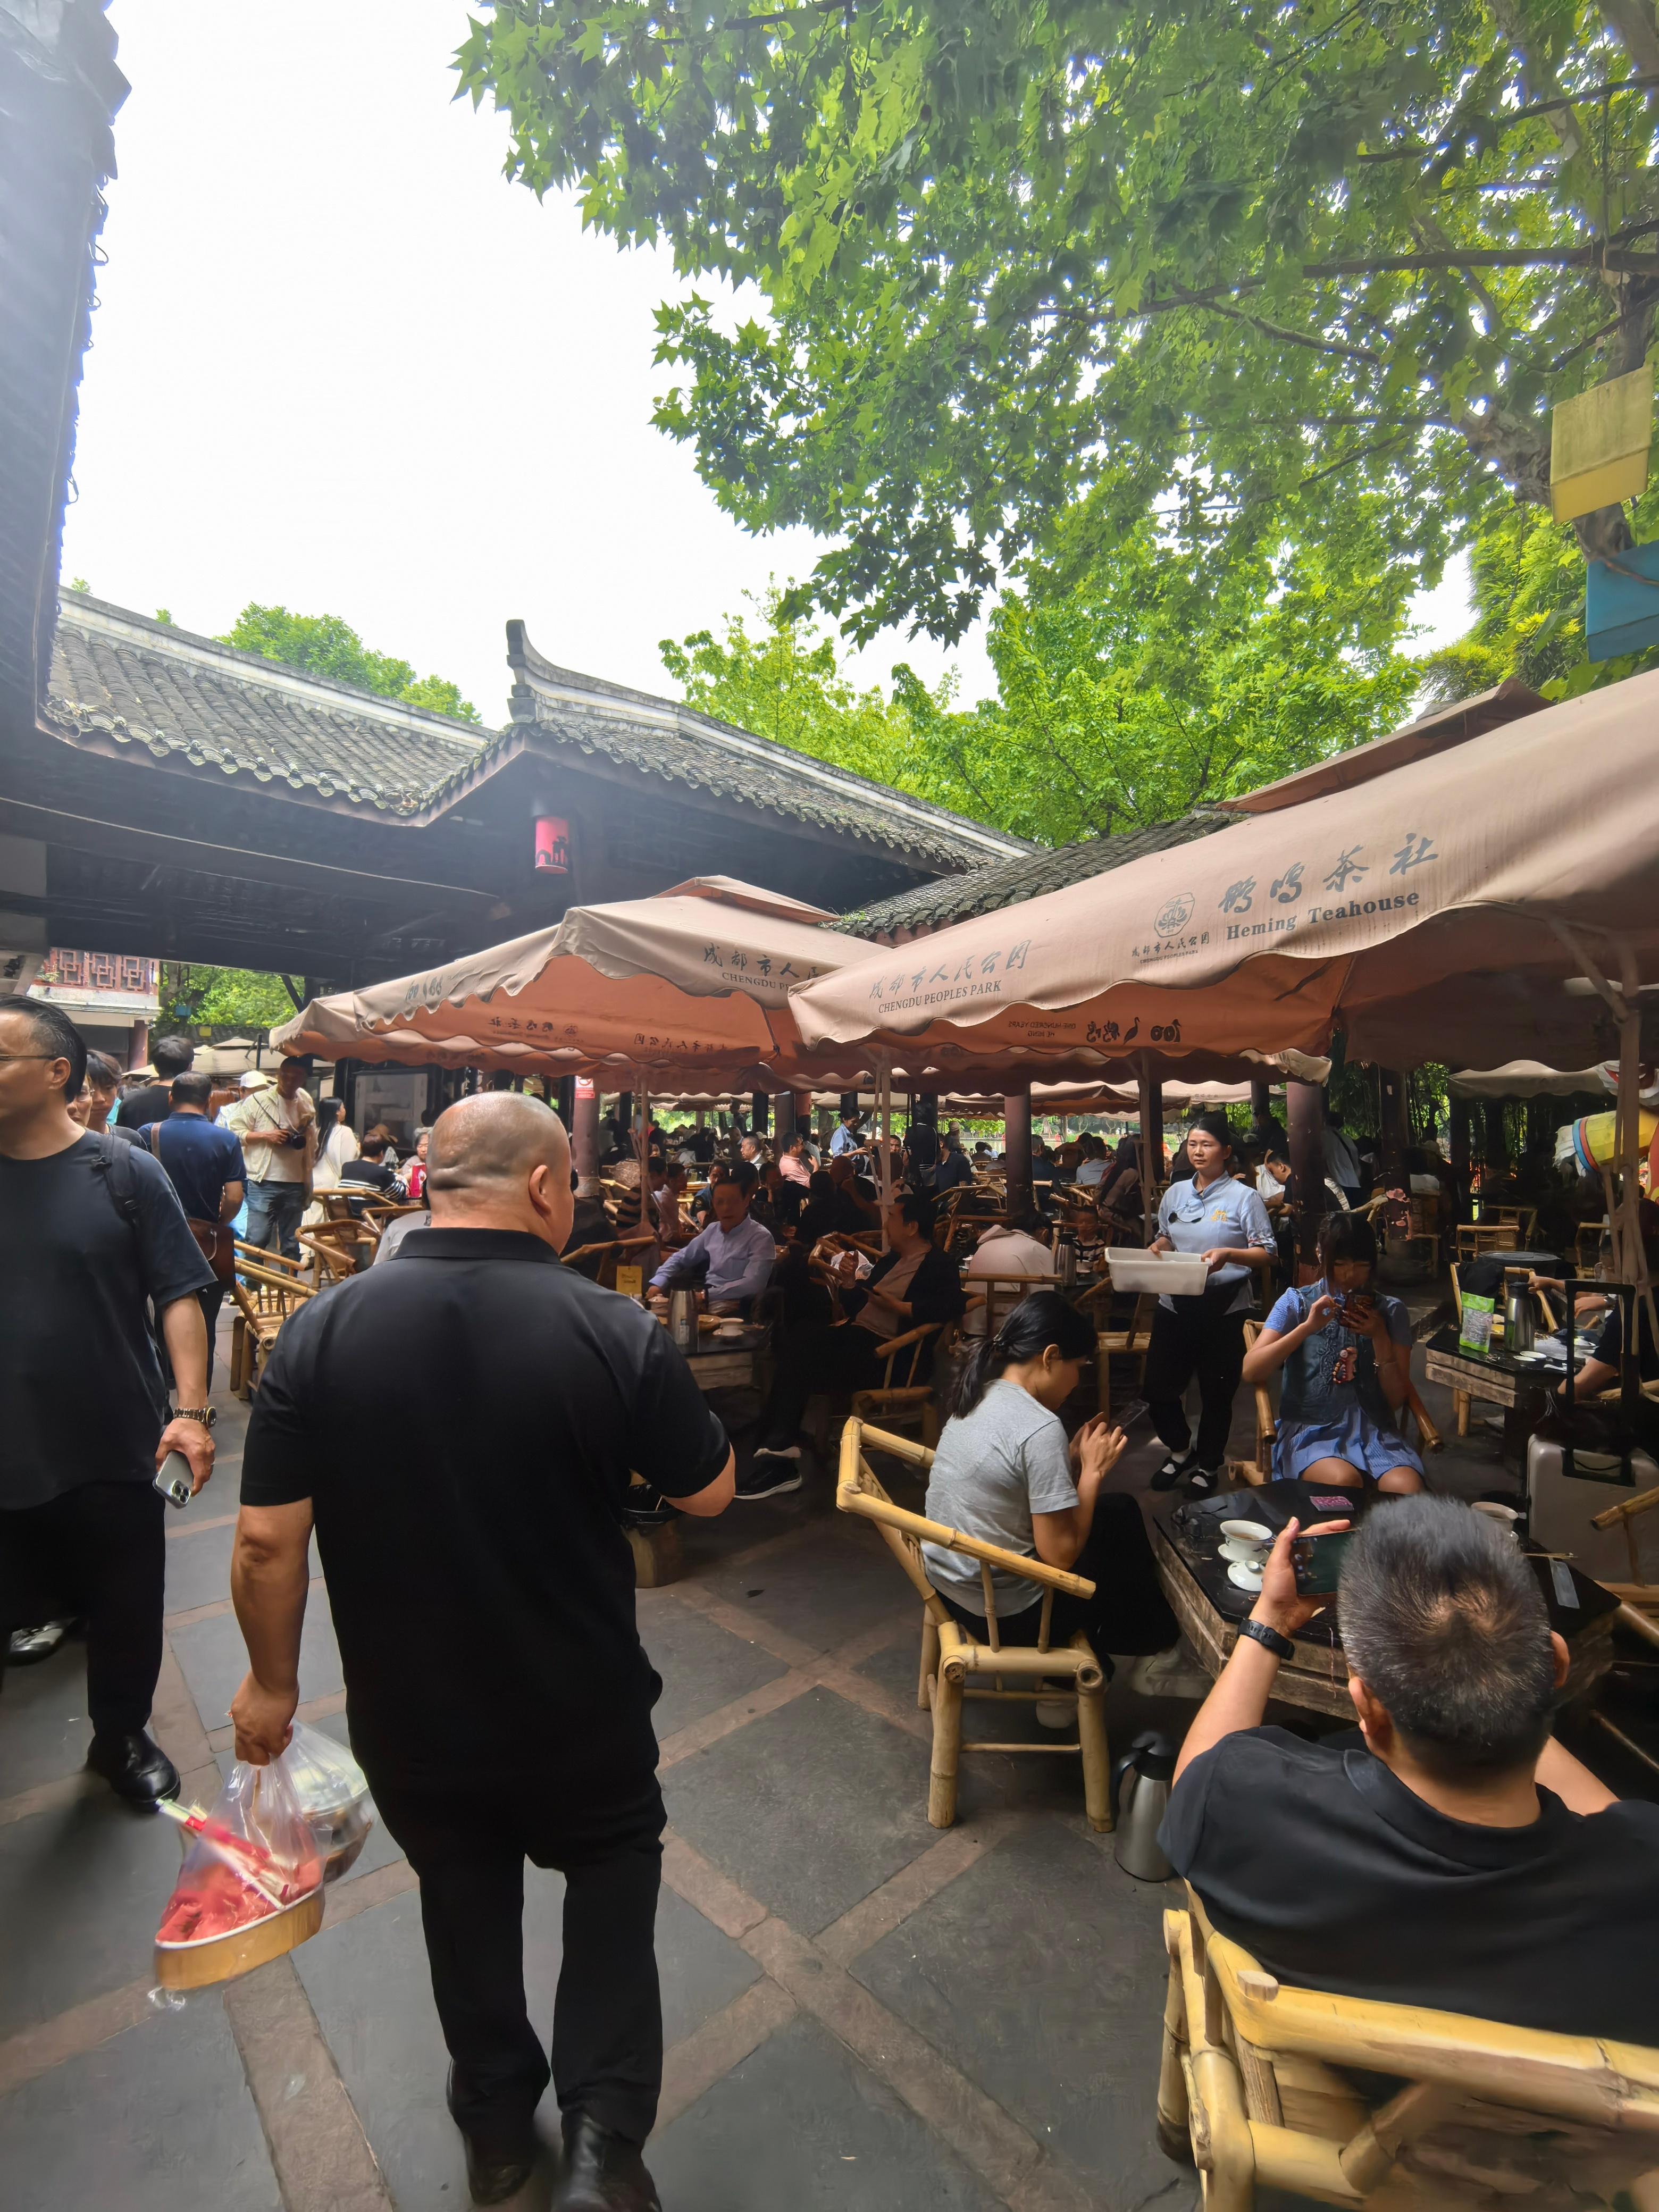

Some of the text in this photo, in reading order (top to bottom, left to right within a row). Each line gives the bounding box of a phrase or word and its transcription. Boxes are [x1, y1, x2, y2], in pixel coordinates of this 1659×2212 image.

[1218, 832, 1439, 914] 鹤鸣茶社
[1226, 892, 1420, 941] Heming Teahouse
[722, 972, 776, 988] CHENGDU
[878, 979, 1002, 1013] CHENGDU PEOPLES PARK
